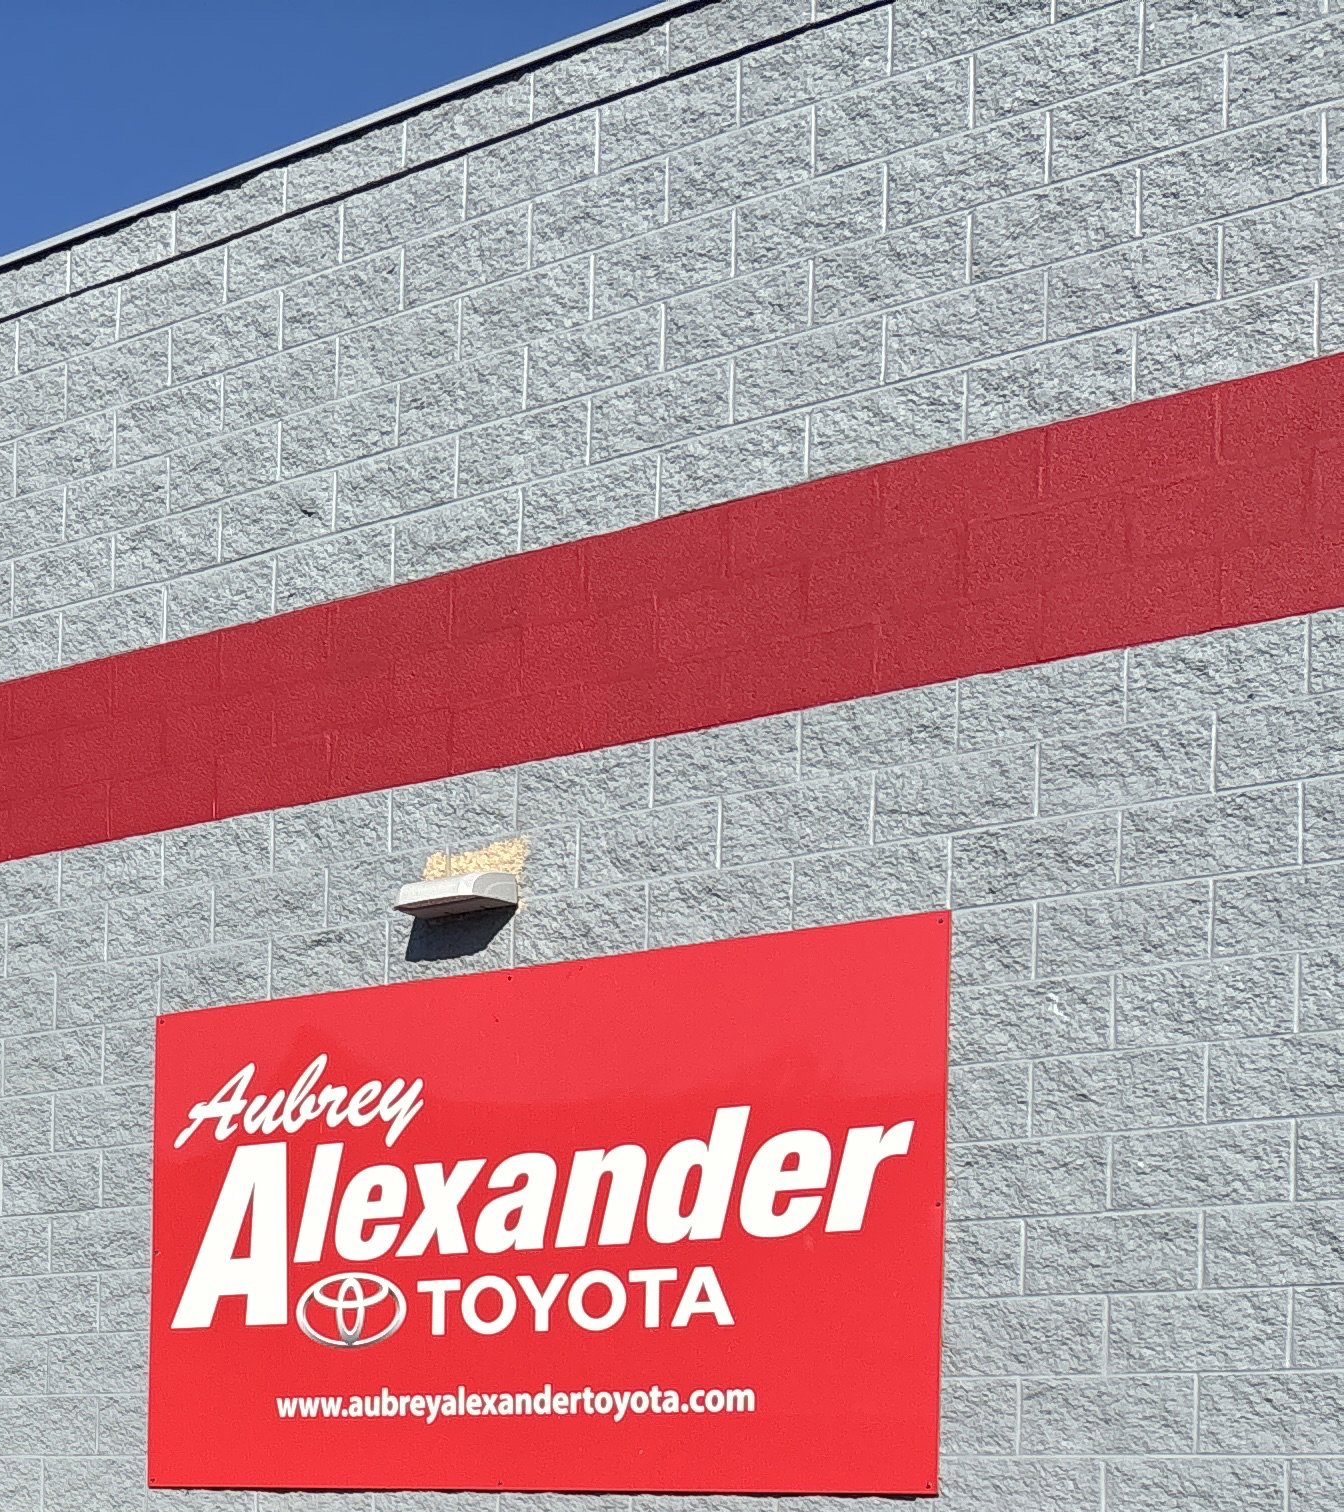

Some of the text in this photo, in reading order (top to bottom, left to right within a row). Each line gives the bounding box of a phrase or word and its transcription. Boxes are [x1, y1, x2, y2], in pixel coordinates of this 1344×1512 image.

[173, 1053, 424, 1149] Aubrey
[170, 1105, 915, 1329] Alexander
[416, 1266, 735, 1336] TOYOTA
[275, 1384, 756, 1425] www.aubreyalexandertoyota.com
